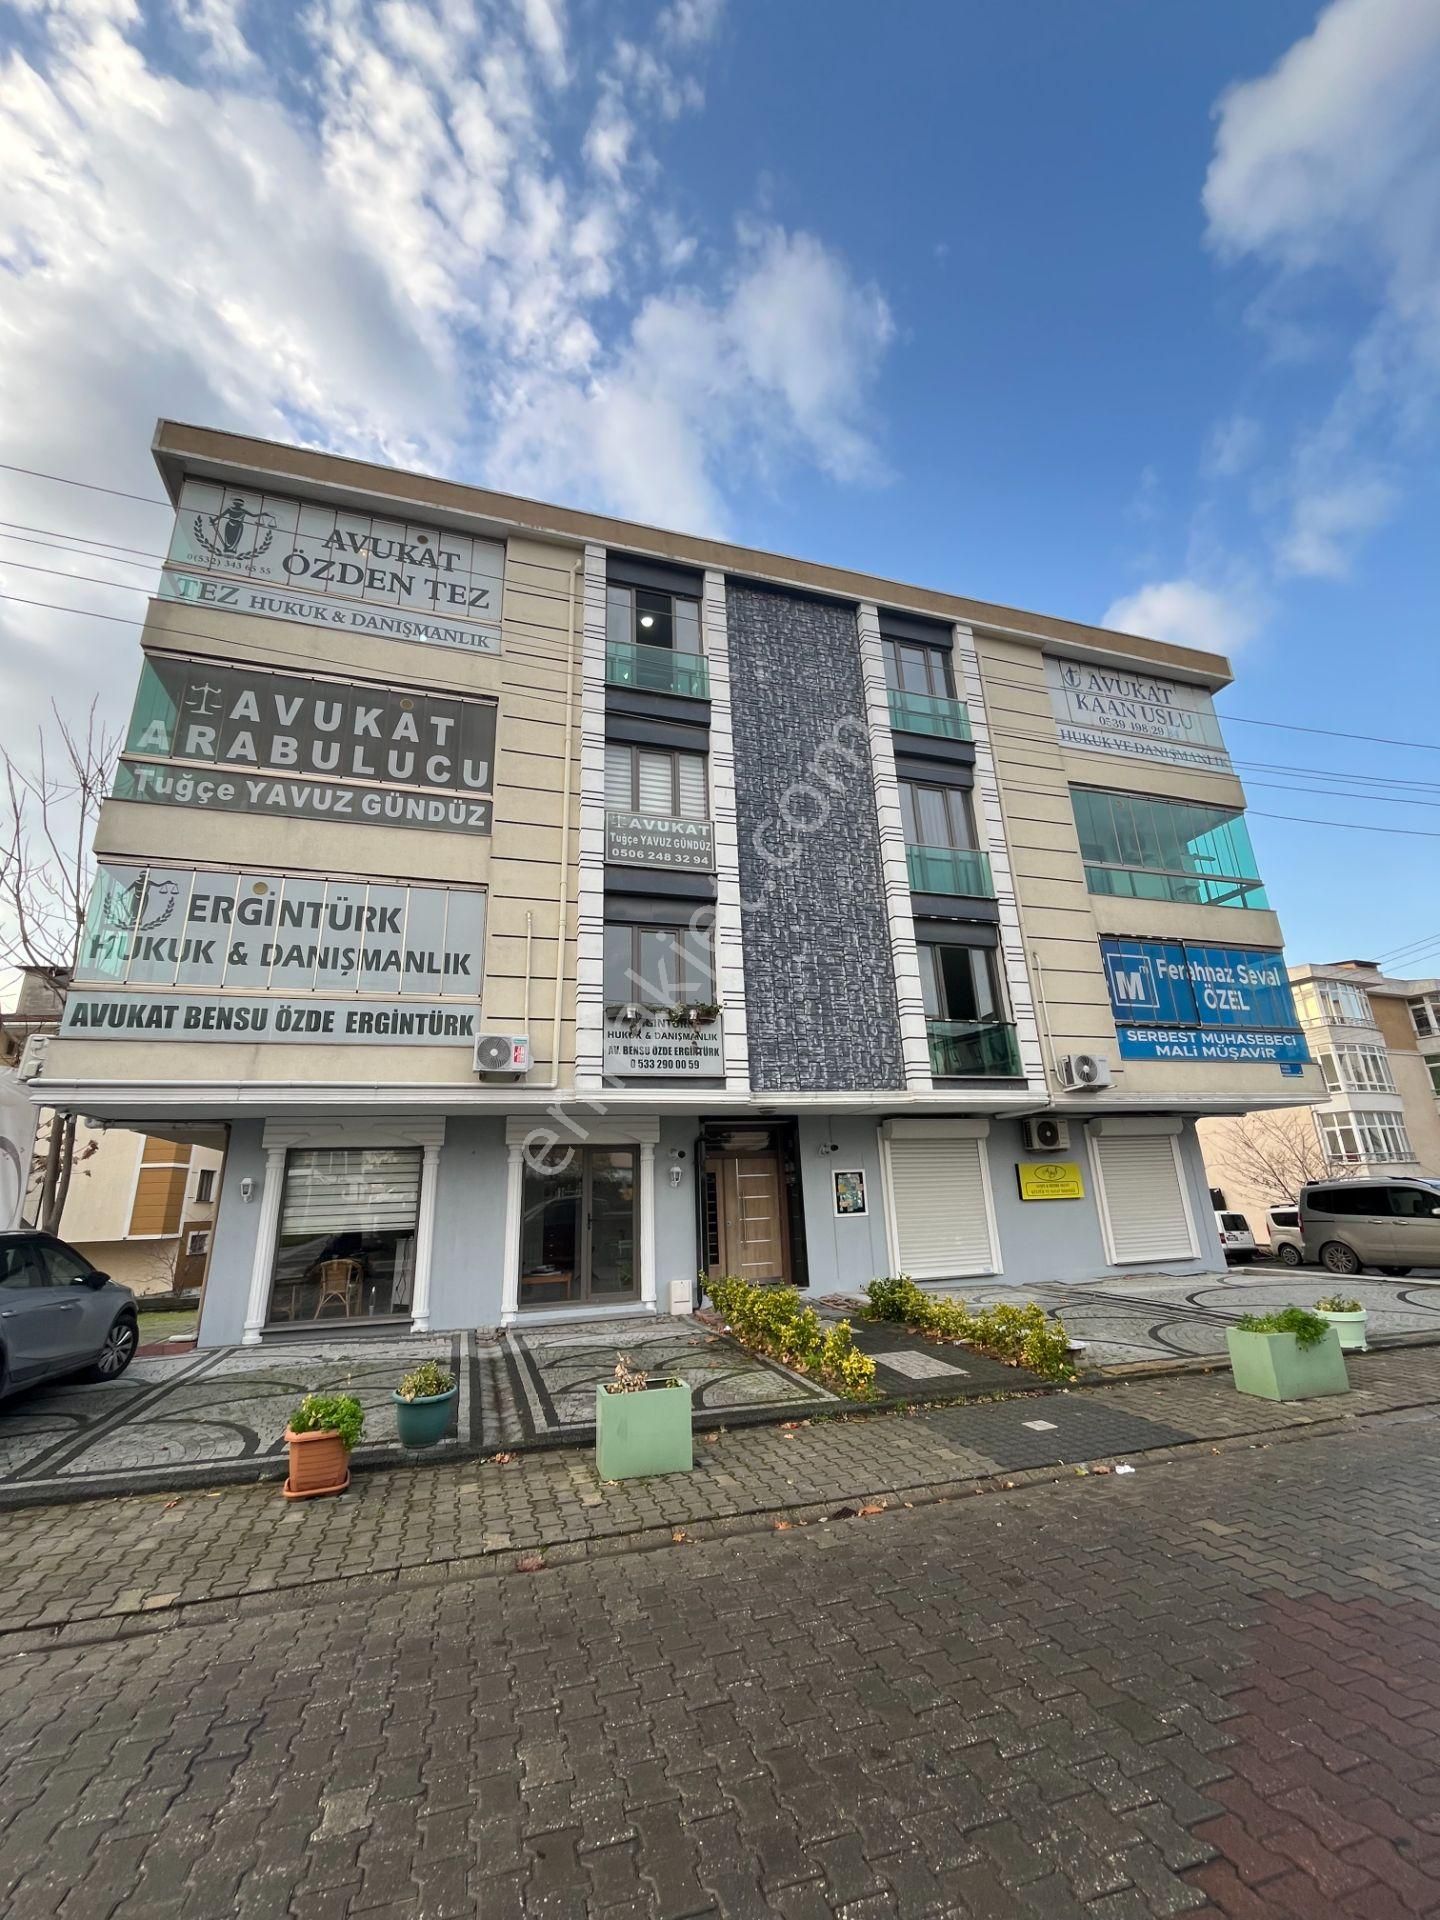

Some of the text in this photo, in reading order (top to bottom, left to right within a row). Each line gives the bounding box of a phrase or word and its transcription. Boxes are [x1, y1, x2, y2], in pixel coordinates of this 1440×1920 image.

[322, 529, 461, 572] AVUKAT
[282, 549, 489, 608] ÖZDEN TEZ
[178, 577, 490, 649] TEZ HUKUK & DANIŞMANLIK
[1088, 674, 1172, 704] AVUKAT
[229, 690, 455, 746] AVUKAT
[1076, 693, 1192, 730] KAAN USLU
[137, 720, 488, 787] ARABULUCU
[1061, 730, 1112, 749] HUKUK
[1113, 738, 1132, 751] VE
[134, 769, 485, 827] Tuğçe YAVUZ GÜNDÜZ
[610, 832, 711, 851] Tuğçe YAVUZ GÜNDÜZ
[629, 818, 710, 836] AVUKAT
[612, 848, 709, 865] 0506 248 32 94
[187, 891, 402, 934] ERGİNTÜRK
[90, 935, 471, 976] HUKUK & DANIŞMANLIK
[1156, 958, 1281, 986] Ferahnaz Seval
[1204, 984, 1250, 1011] ÖZEL
[70, 1002, 474, 1036] AVUKAT BENSU ÖZDE ERGİNTÜRK
[623, 1046, 650, 1056] BENSU
[653, 1045, 672, 1056] ÖZDE
[655, 1033, 717, 1042] DANIŞMANLIK
[1127, 1030, 1196, 1045] SERBEST
[638, 1060, 655, 1069] 533
[657, 1060, 673, 1069] 290
[676, 1060, 686, 1069] 00
[689, 1060, 700, 1069] 59
